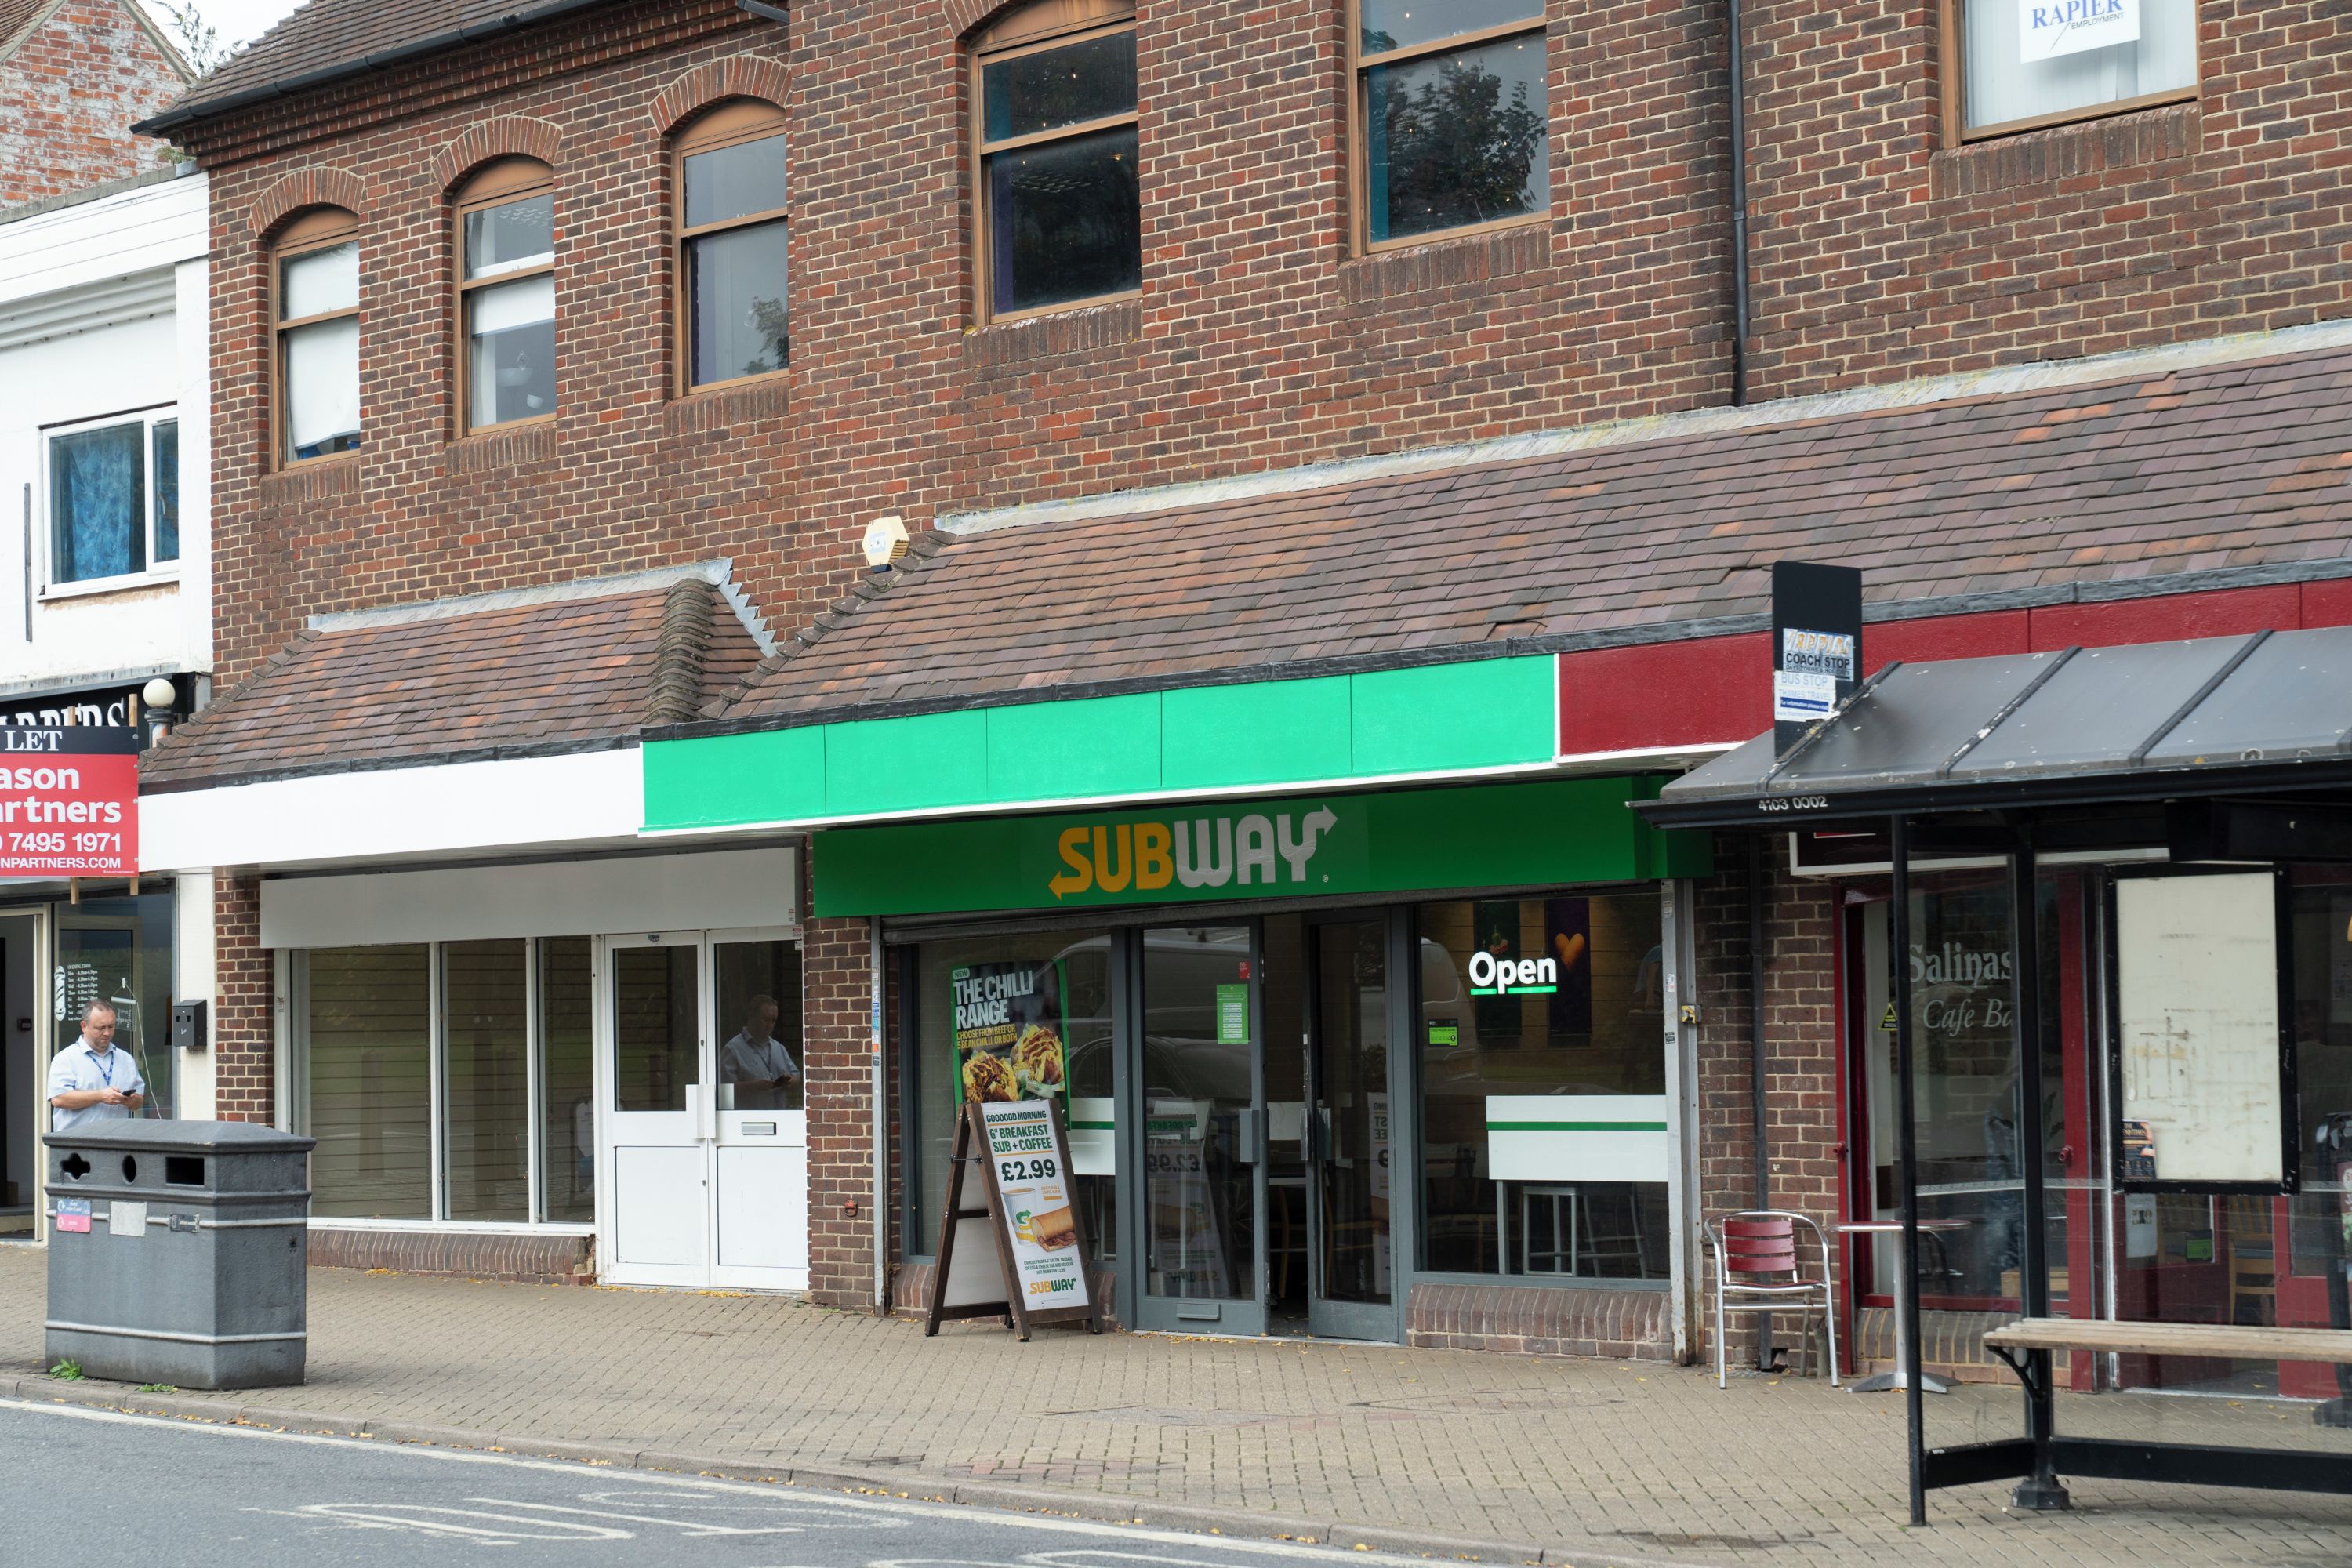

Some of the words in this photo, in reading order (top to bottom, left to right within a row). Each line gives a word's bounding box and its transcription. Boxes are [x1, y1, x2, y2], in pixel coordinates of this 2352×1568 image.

[2032, 0, 2122, 29] RAPIER
[2071, 12, 2124, 29] EMPLOYMENT
[1786, 652, 1821, 666] COACH
[1824, 656, 1849, 669] STOP
[1781, 673, 1801, 684] BUS
[1803, 675, 1828, 687] STOP
[4, 730, 63, 751] LET
[0, 796, 122, 823] rtners
[1792, 796, 1828, 808] 0002
[8, 833, 65, 852] 7495
[72, 833, 121, 852] 1971
[1048, 804, 1338, 900] SUBWAY
[0, 857, 121, 869] NPARTNERS.COM
[954, 969, 967, 978] NEW
[1468, 951, 1557, 994] Open
[953, 978, 984, 1005] THE
[985, 970, 1033, 1001] CHILLI
[955, 999, 1010, 1029] RANGE
[1923, 999, 1974, 1036] Cafe
[956, 1029, 978, 1040] CHOOSE
[978, 1027, 994, 1036] FROM
[994, 1025, 1007, 1035] BEEF
[1007, 1024, 1015, 1033] OR
[957, 1041, 961, 1050] 5
[961, 1039, 975, 1049] BEAN
[994, 1035, 1002, 1044] OR
[1002, 1033, 1018, 1044] BOTH
[1018, 1110, 1047, 1120] MORNING
[999, 1124, 1048, 1139] BREAKFAST
[993, 1140, 1012, 1152] SUB
[1018, 1138, 1052, 1150] COFFEE
[1001, 1159, 1055, 1181] £2.99
[1029, 1277, 1076, 1295] SUBWAY
